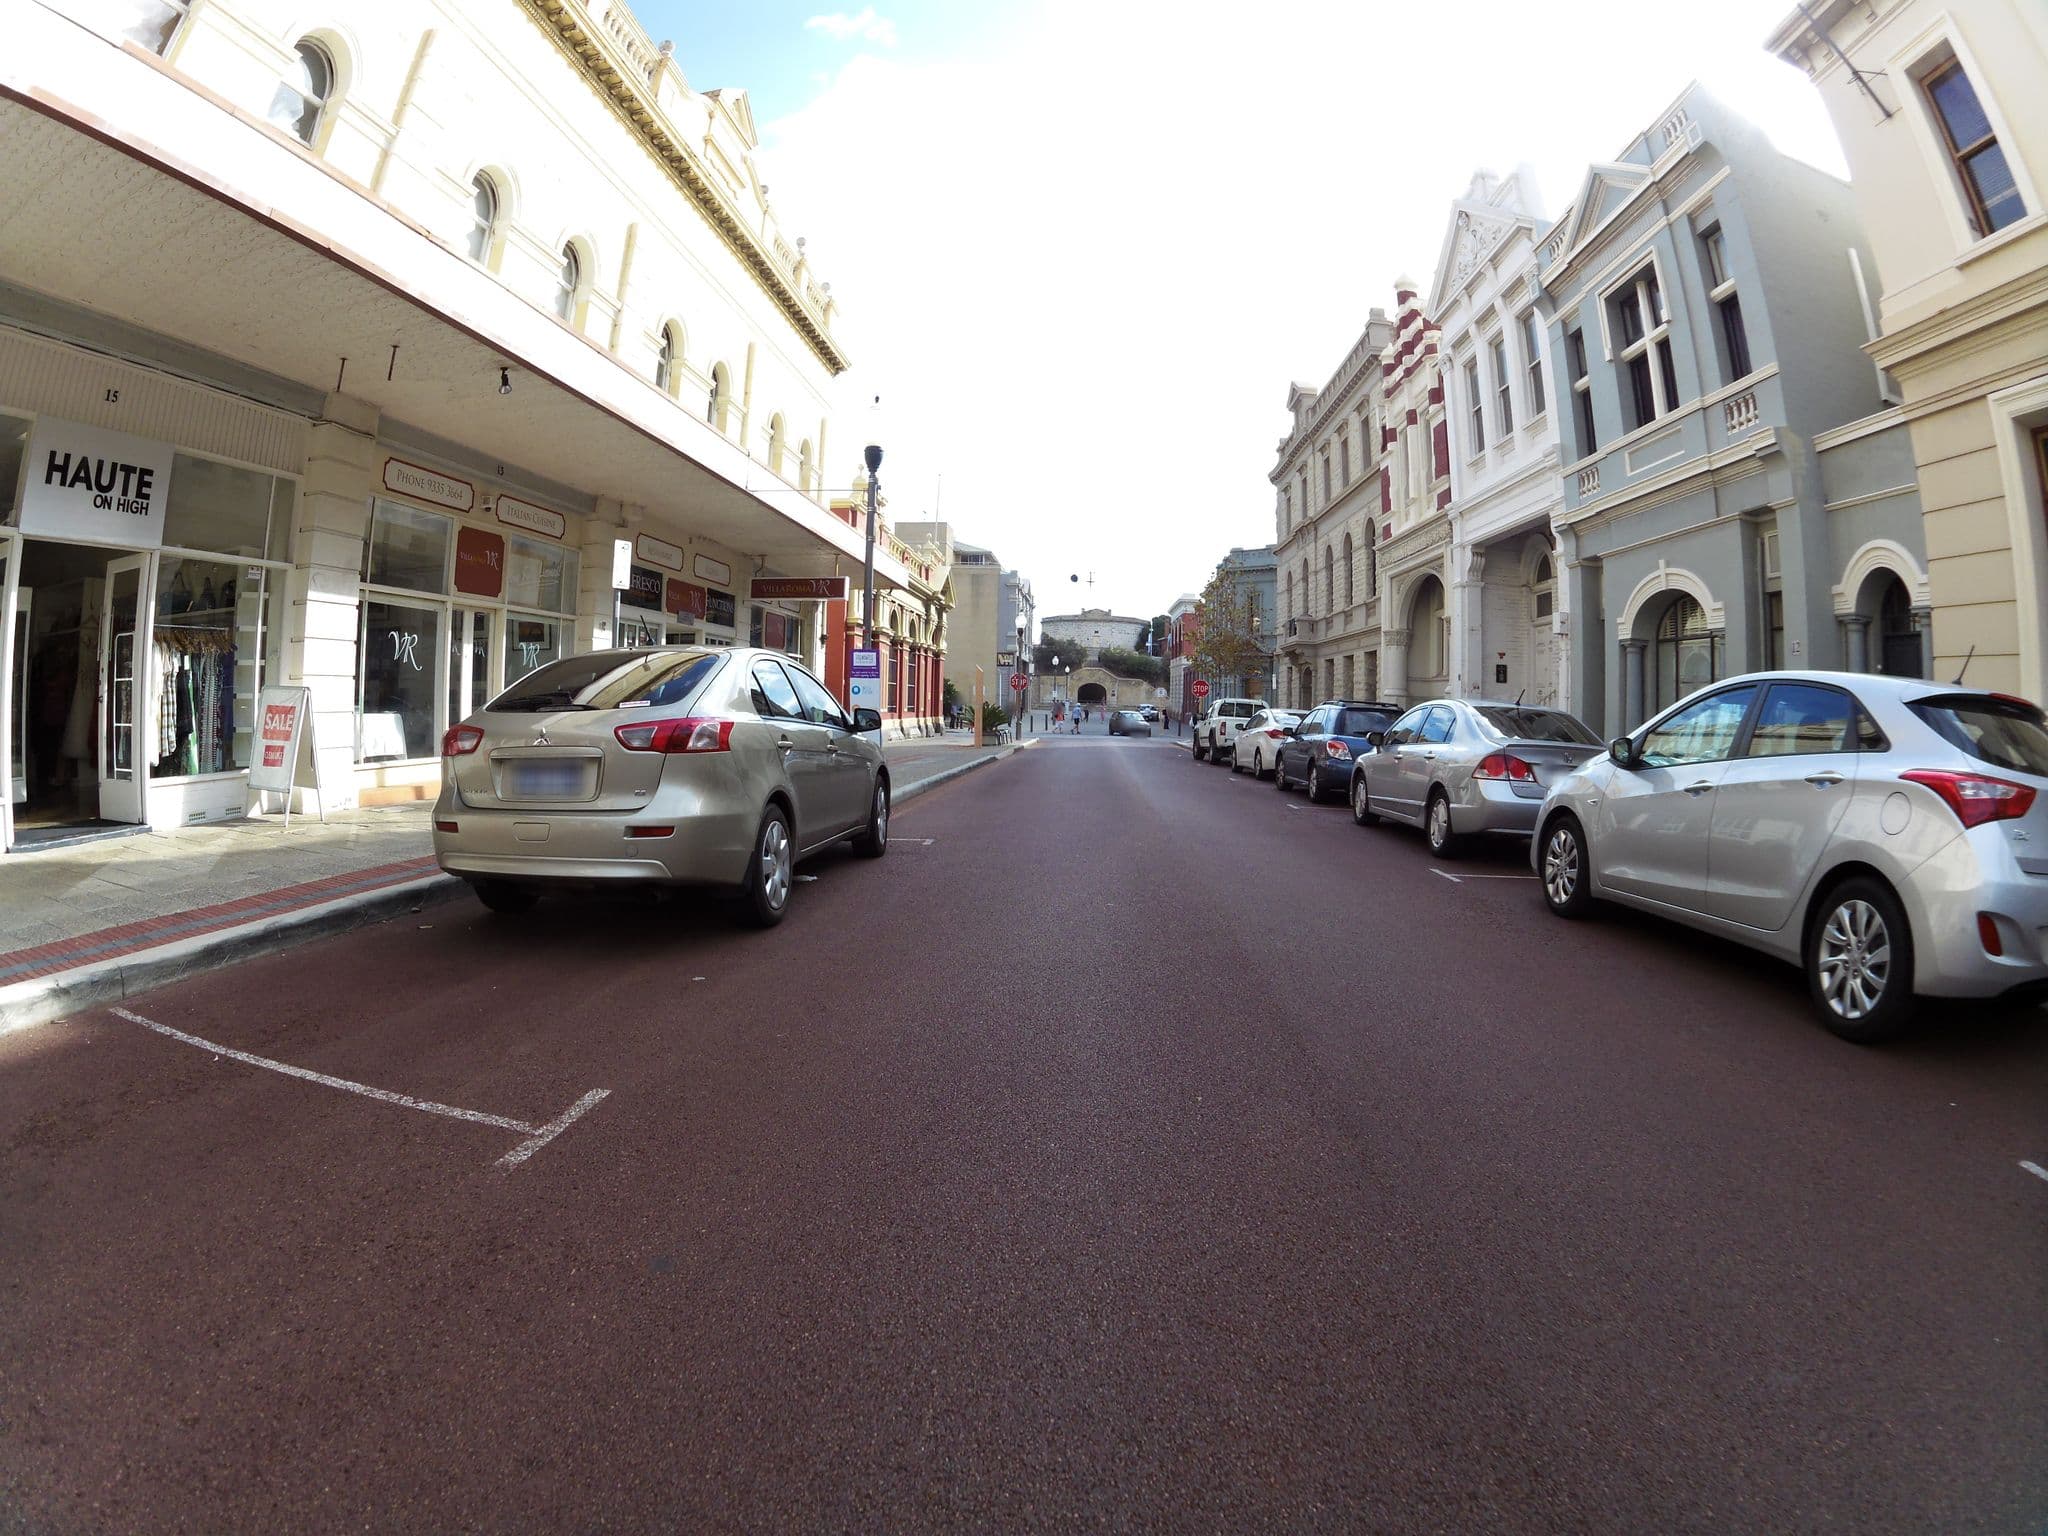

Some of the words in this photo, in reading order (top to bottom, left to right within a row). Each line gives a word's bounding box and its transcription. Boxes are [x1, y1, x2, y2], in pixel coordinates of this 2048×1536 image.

[104, 389, 119, 403] 15
[44, 450, 154, 500] HAUTE
[396, 469, 425, 489] PHONE
[427, 479, 445, 495] 9335
[93, 493, 113, 511] ON
[116, 498, 149, 516] HIGH
[1193, 685, 1209, 693] STOP
[265, 713, 294, 730] SALE
